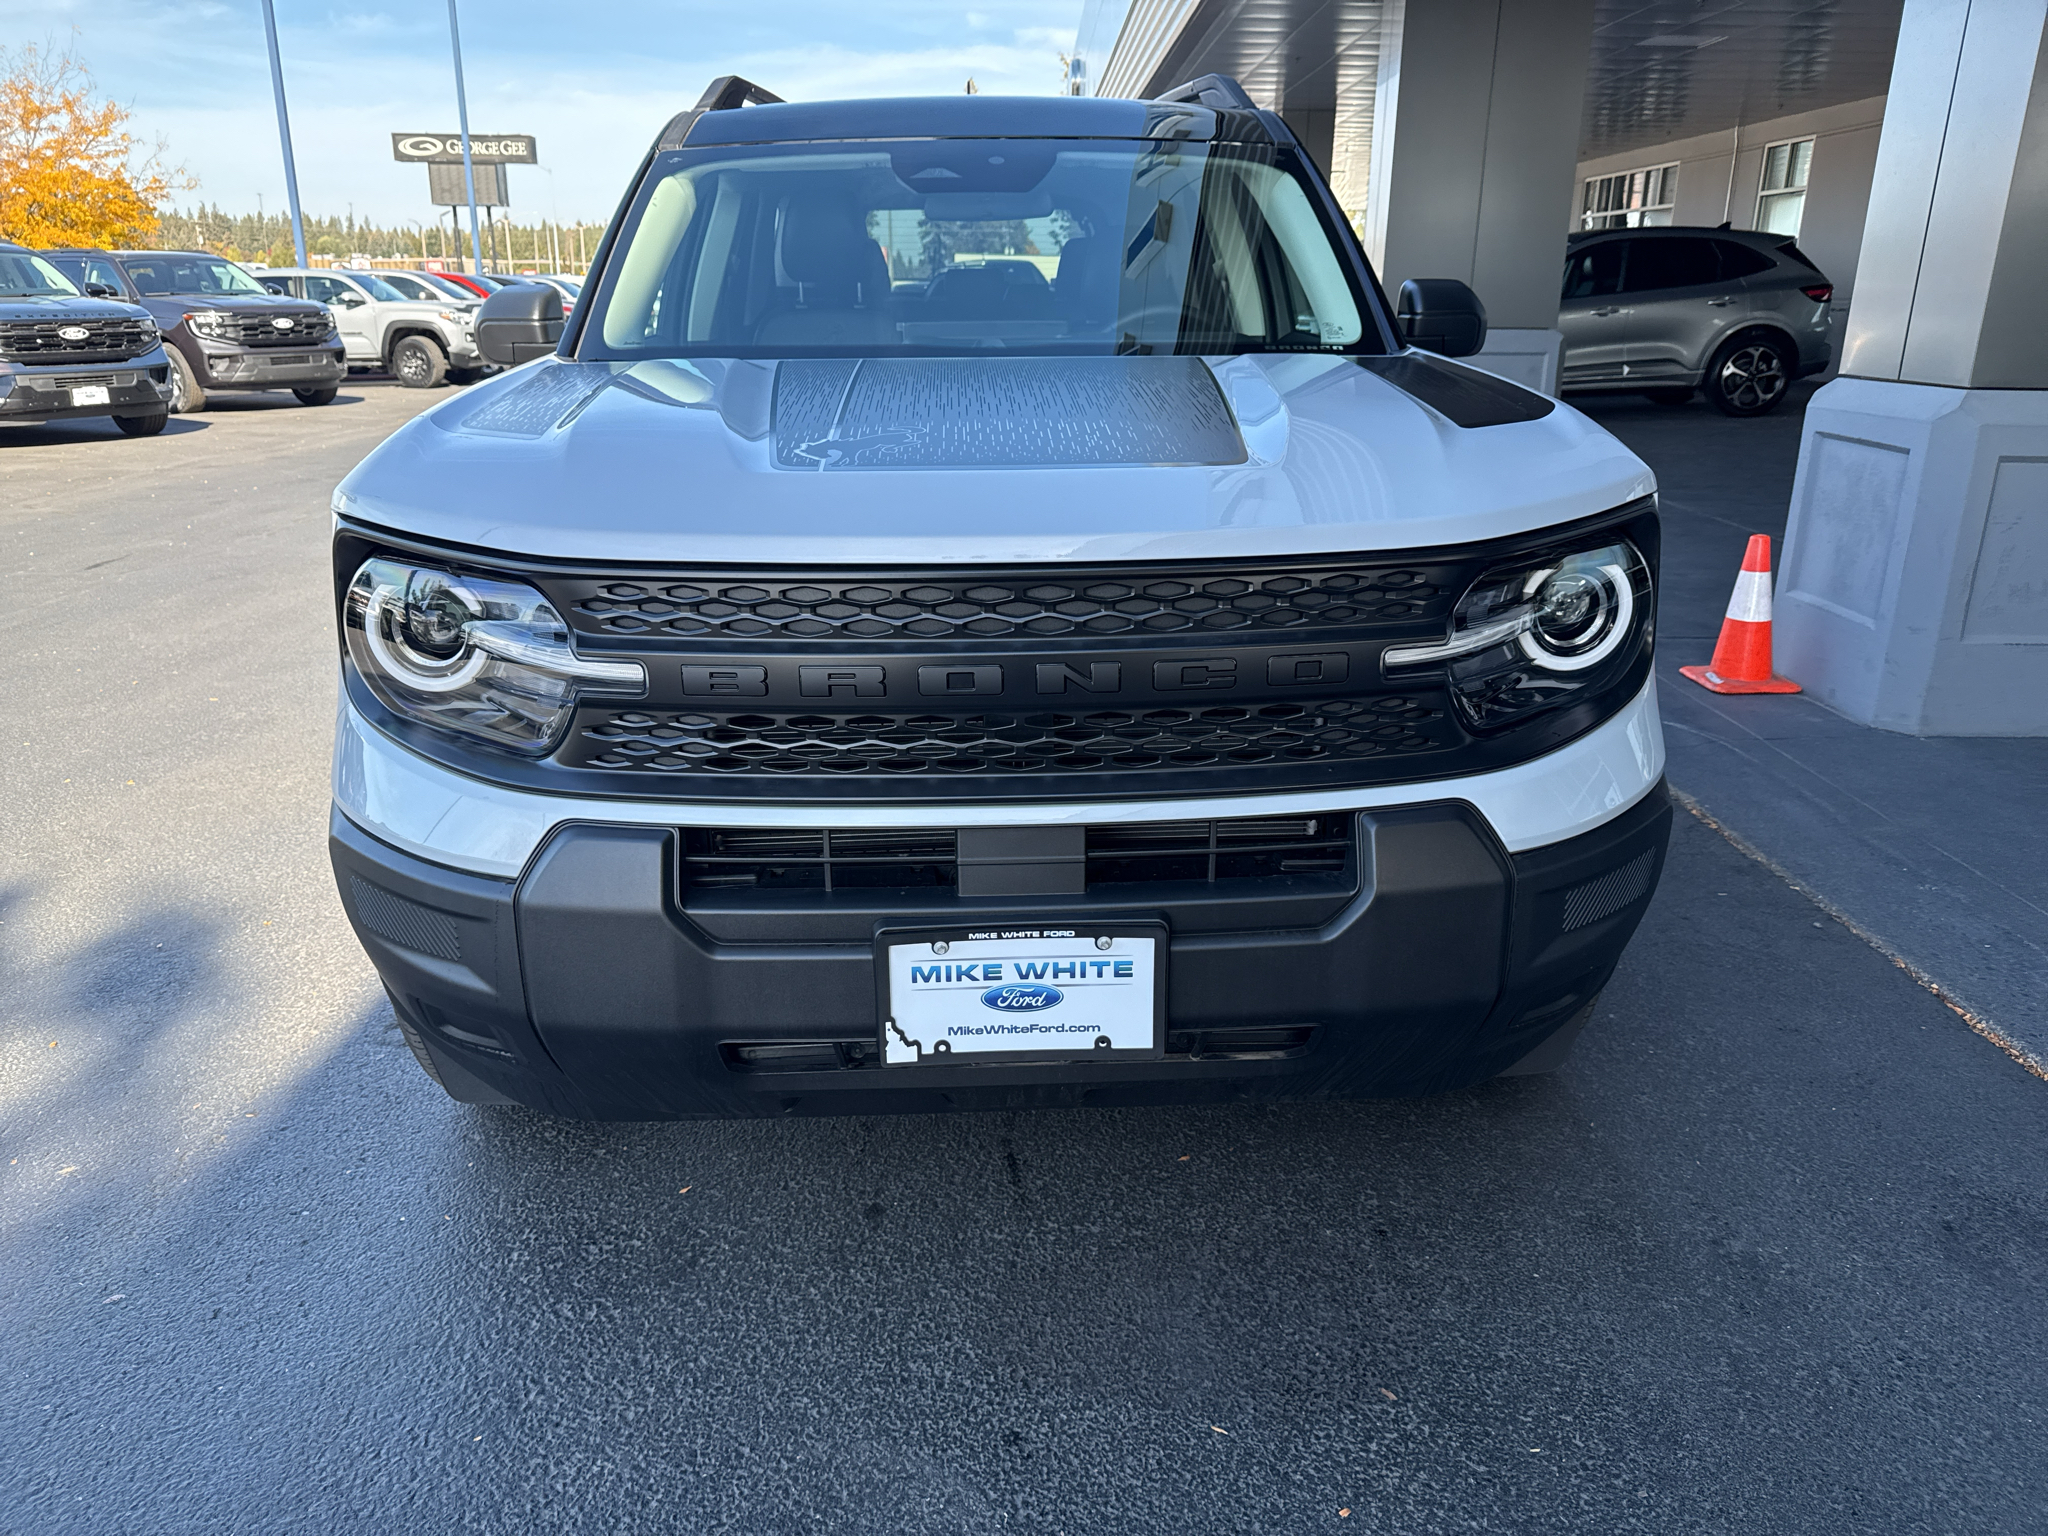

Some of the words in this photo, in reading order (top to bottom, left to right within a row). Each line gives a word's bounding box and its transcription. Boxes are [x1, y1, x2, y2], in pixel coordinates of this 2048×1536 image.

[500, 140, 527, 156] GEE
[681, 652, 1350, 698] BRONCO
[968, 932, 998, 940] MIKE
[1000, 930, 1040, 939] WHITE
[1043, 930, 1076, 938] FORD
[911, 963, 1003, 984] MIKE
[1013, 960, 1134, 980] WHITE
[997, 987, 1048, 1008] Ford
[948, 1023, 1101, 1037] MikeWhiteFord.com
